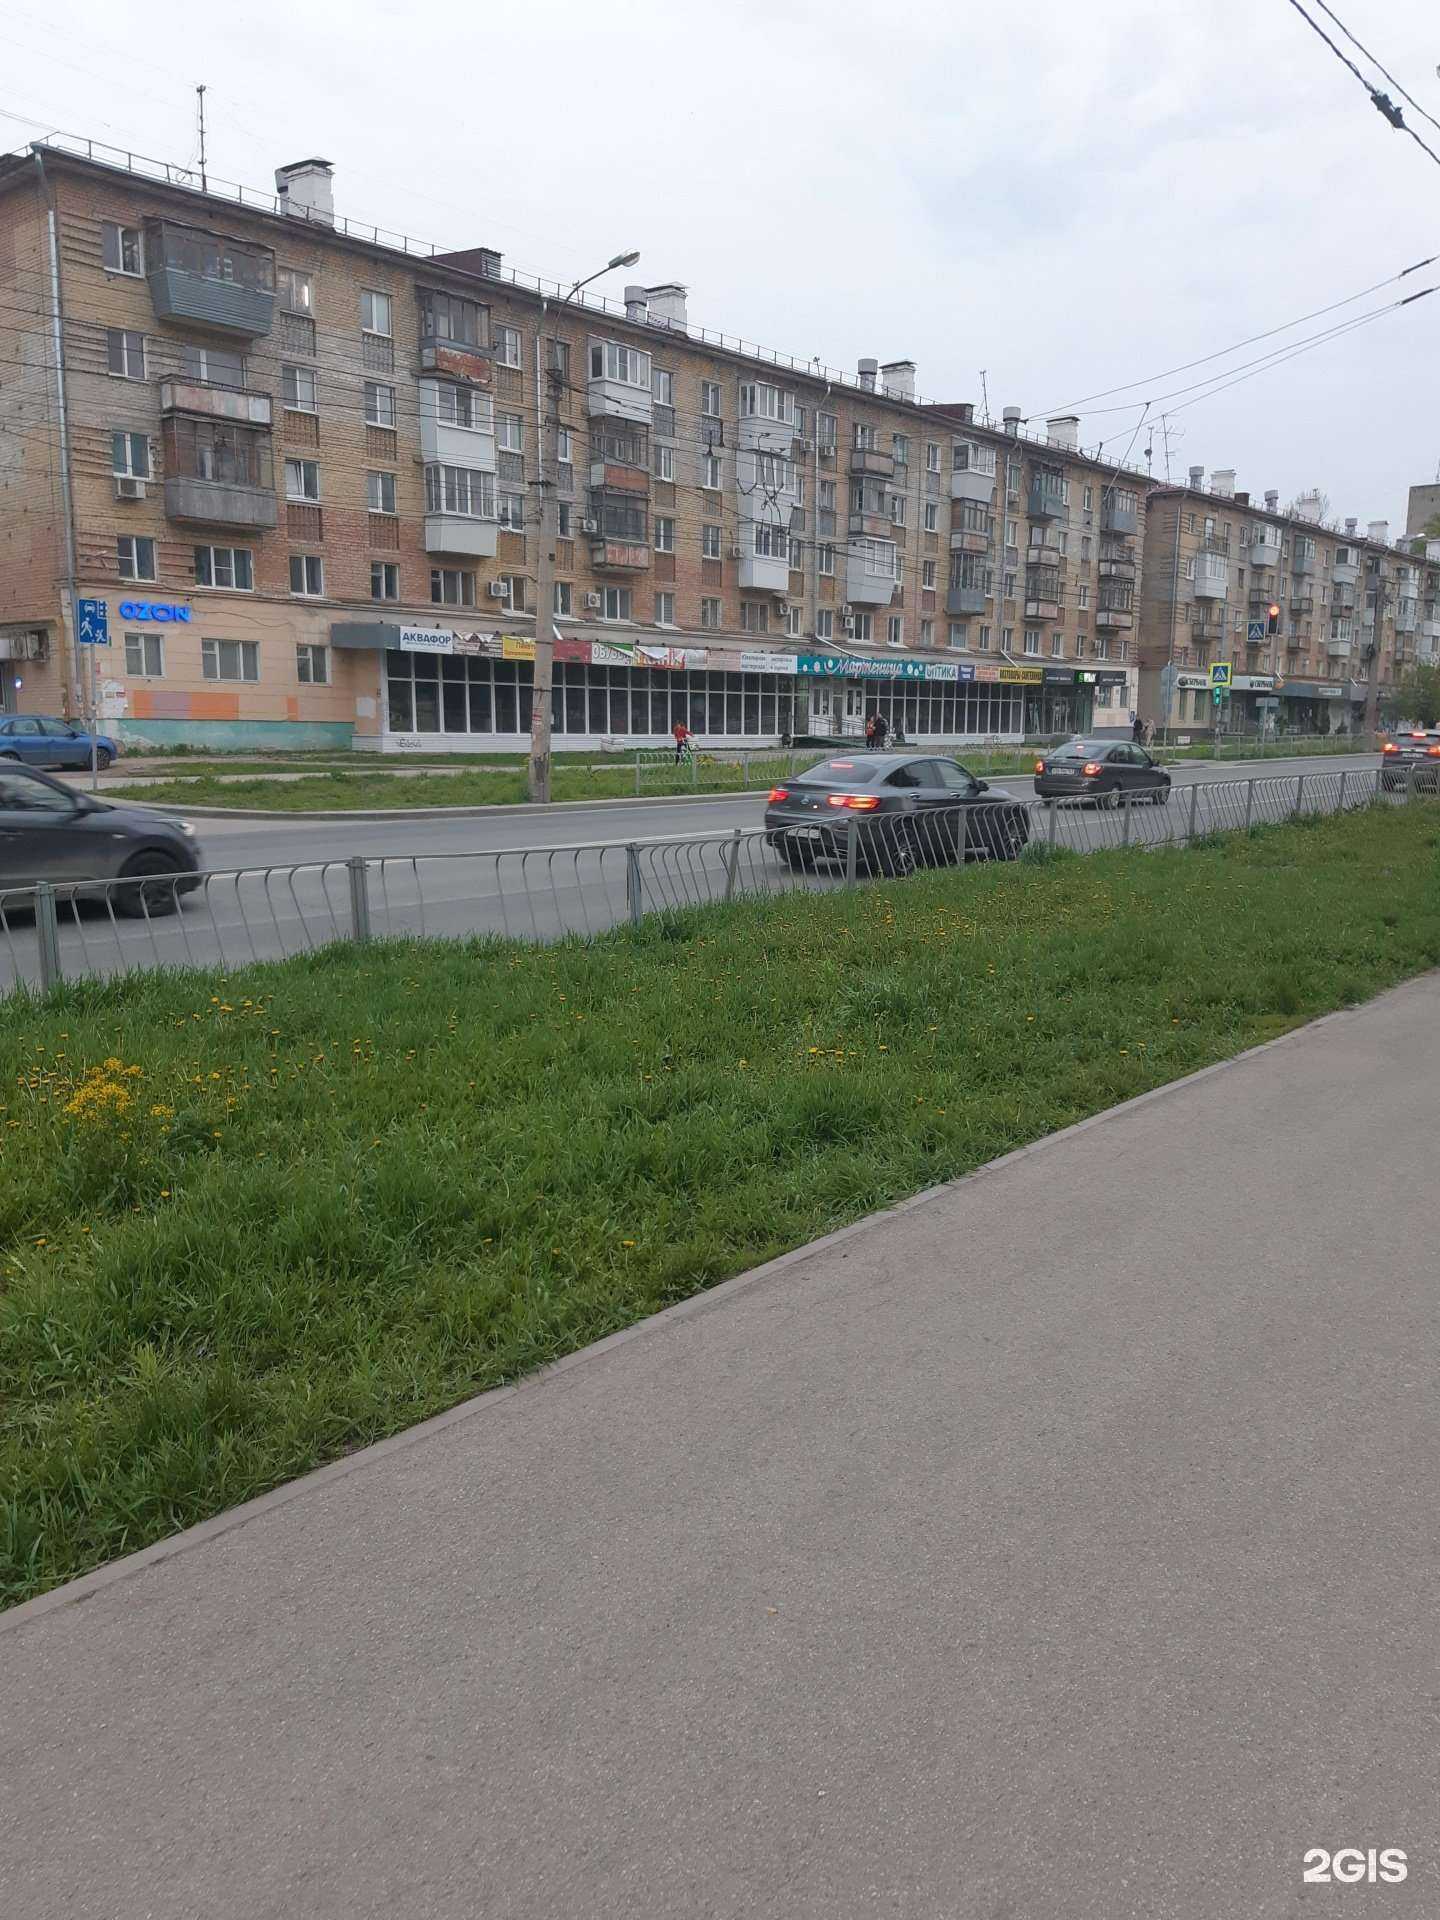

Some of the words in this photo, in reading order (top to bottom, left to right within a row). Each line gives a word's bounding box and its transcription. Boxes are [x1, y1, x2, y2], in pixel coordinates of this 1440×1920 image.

[119, 601, 191, 623] OZON
[402, 632, 451, 644] АКВАФОР
[926, 664, 957, 679] ОПТИКА
